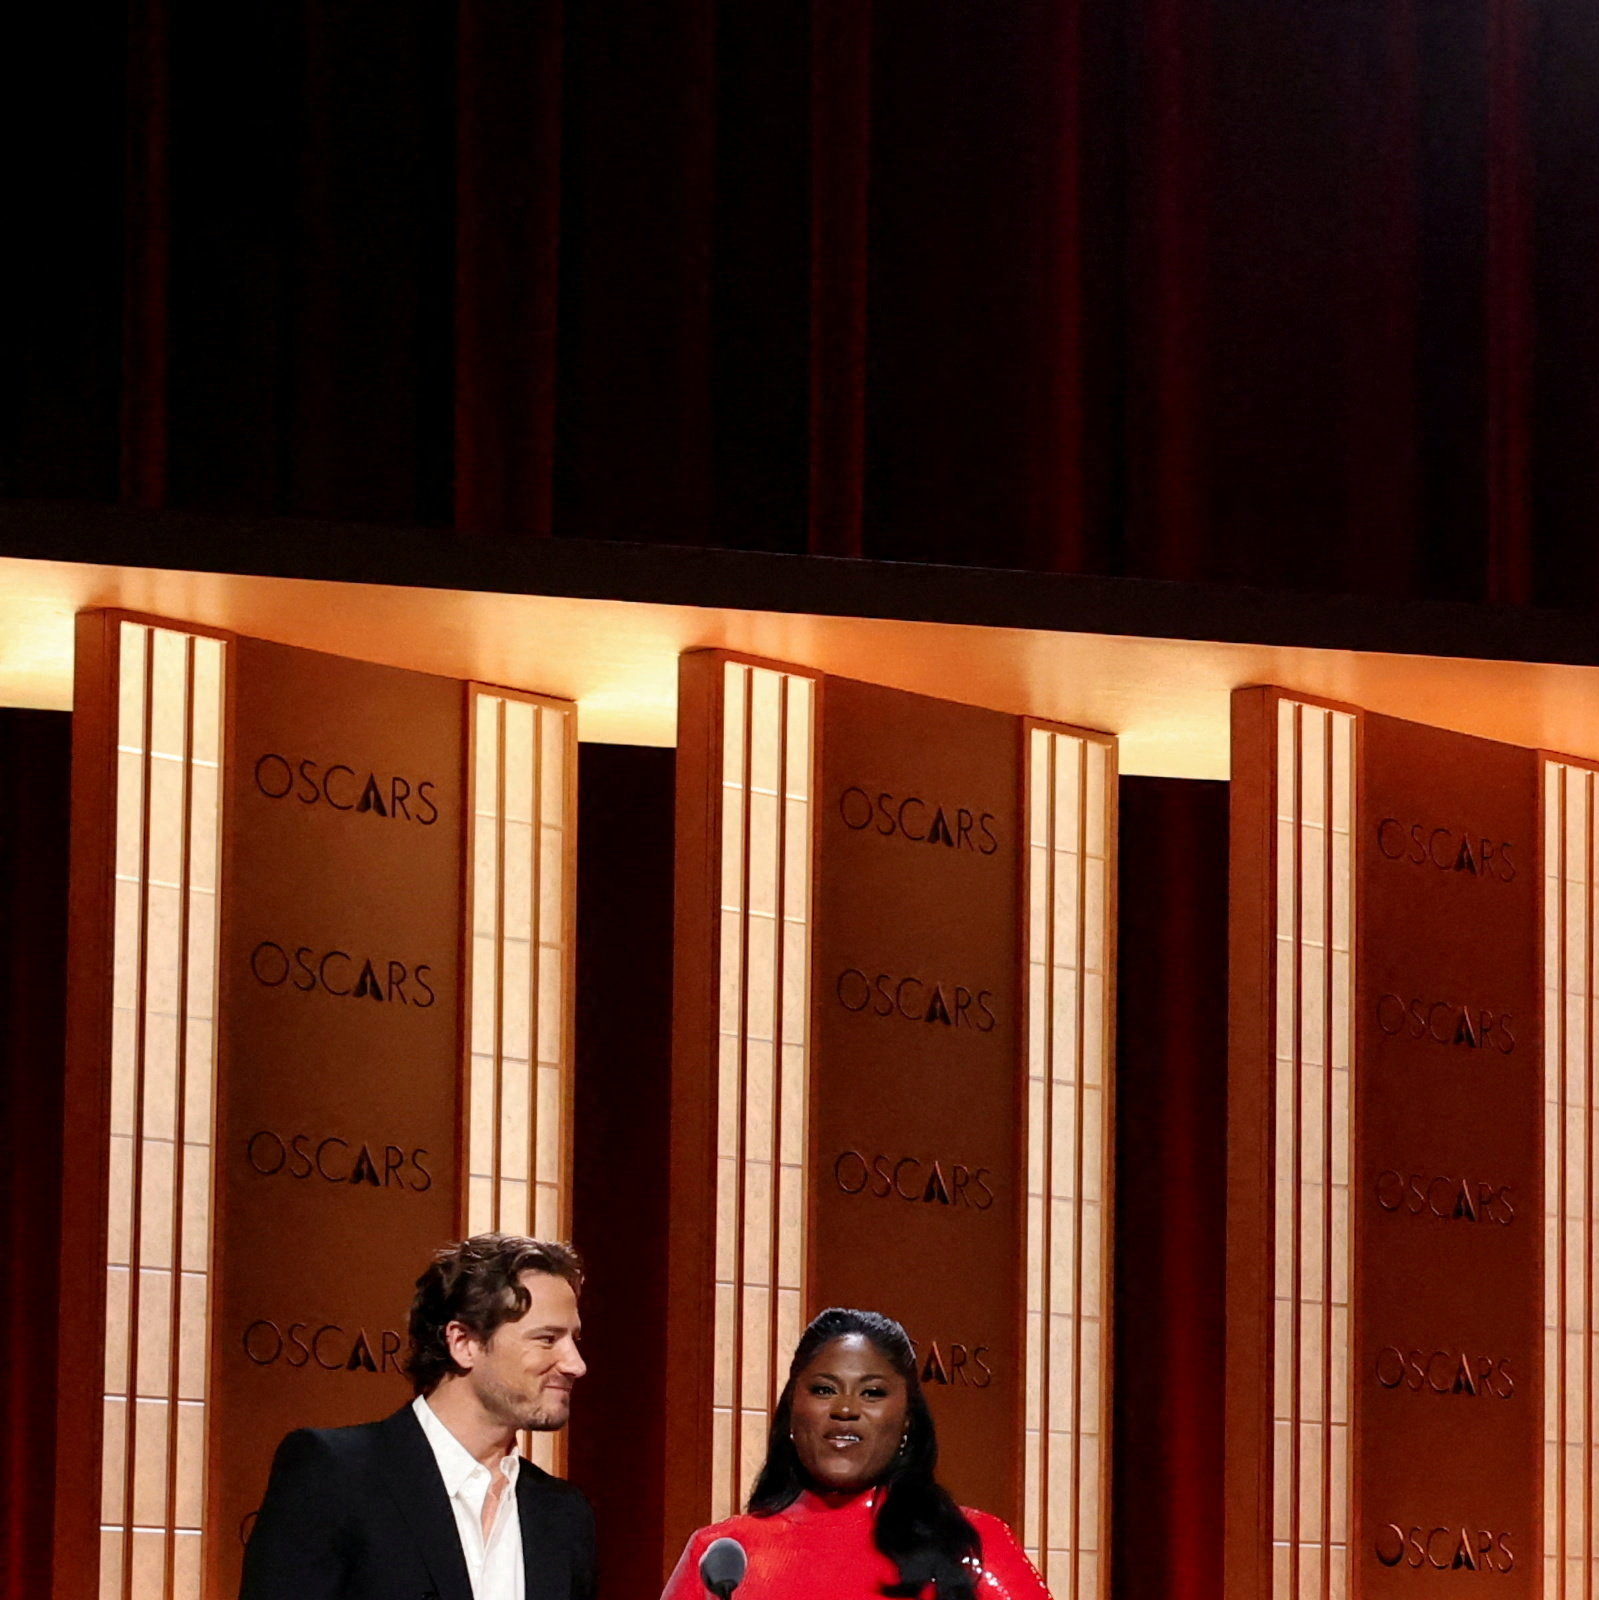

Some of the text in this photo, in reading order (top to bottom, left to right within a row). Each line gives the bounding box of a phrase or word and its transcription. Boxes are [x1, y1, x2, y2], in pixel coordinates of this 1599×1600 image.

[255, 753, 438, 825] OSCARS
[839, 786, 998, 855] OSCARS
[1377, 817, 1517, 883] OSCARS
[251, 941, 435, 1008] OSCARS
[837, 968, 996, 1033] OSCARS
[1376, 993, 1516, 1055] OSCARS
[248, 1130, 432, 1192] OSCARS
[834, 1150, 995, 1210] OSCARS
[1375, 1168, 1515, 1227] OSCARS
[243, 1318, 406, 1375] OSCAR
[1375, 1345, 1515, 1400] OSCARS
[1374, 1523, 1514, 1574] OSCARS
